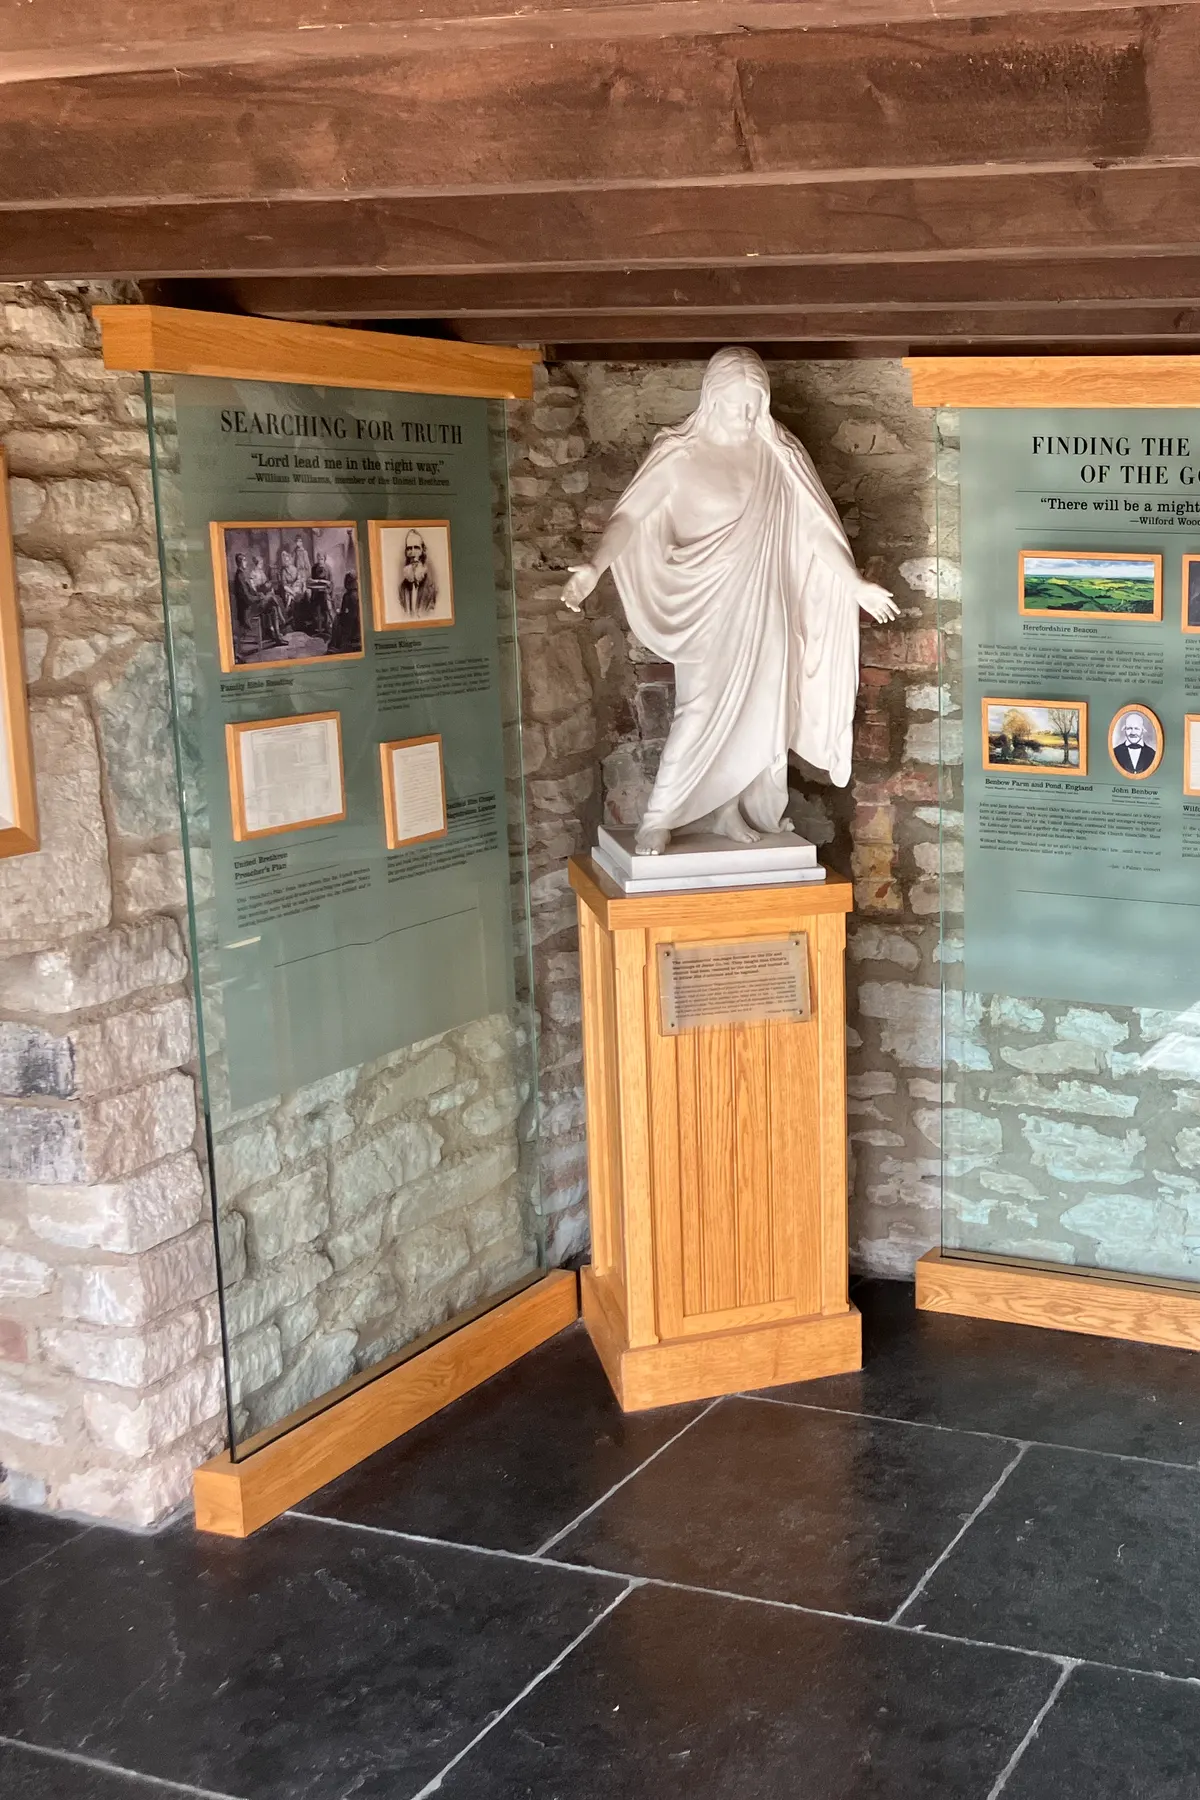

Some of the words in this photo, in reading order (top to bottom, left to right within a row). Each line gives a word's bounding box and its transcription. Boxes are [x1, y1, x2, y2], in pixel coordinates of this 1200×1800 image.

[220, 409, 348, 439] SEARCHING
[356, 419, 394, 441] FOR
[402, 421, 463, 445] TRUTH
[1032, 436, 1131, 456] FINDING
[1141, 437, 1190, 457] THE
[251, 454, 289, 468] “Lord
[294, 455, 320, 469] lead
[325, 460, 343, 470] me
[346, 458, 358, 470] in
[362, 458, 381, 471] the
[385, 459, 413, 474] right
[416, 461, 445, 475] way.”
[1080, 465, 1110, 483] OF
[1120, 465, 1169, 484] THE
[1040, 498, 1088, 511] “There
[1093, 499, 1119, 511] will
[1124, 501, 1139, 512] be
[1144, 504, 1152, 512] a
[1130, 516, 1174, 526] —Wilford
[1023, 624, 1071, 633] Herefordshire
[1073, 626, 1098, 634] Beacon
[985, 779, 1010, 787] Benbow
[1012, 780, 1030, 788] Farm
[1031, 781, 1044, 789] and
[1045, 782, 1064, 790] Pond,
[1065, 784, 1093, 792] England
[1111, 787, 1129, 795] John
[1131, 787, 1158, 796] Benbow
[234, 859, 257, 869] United
[272, 863, 287, 872] Plan
